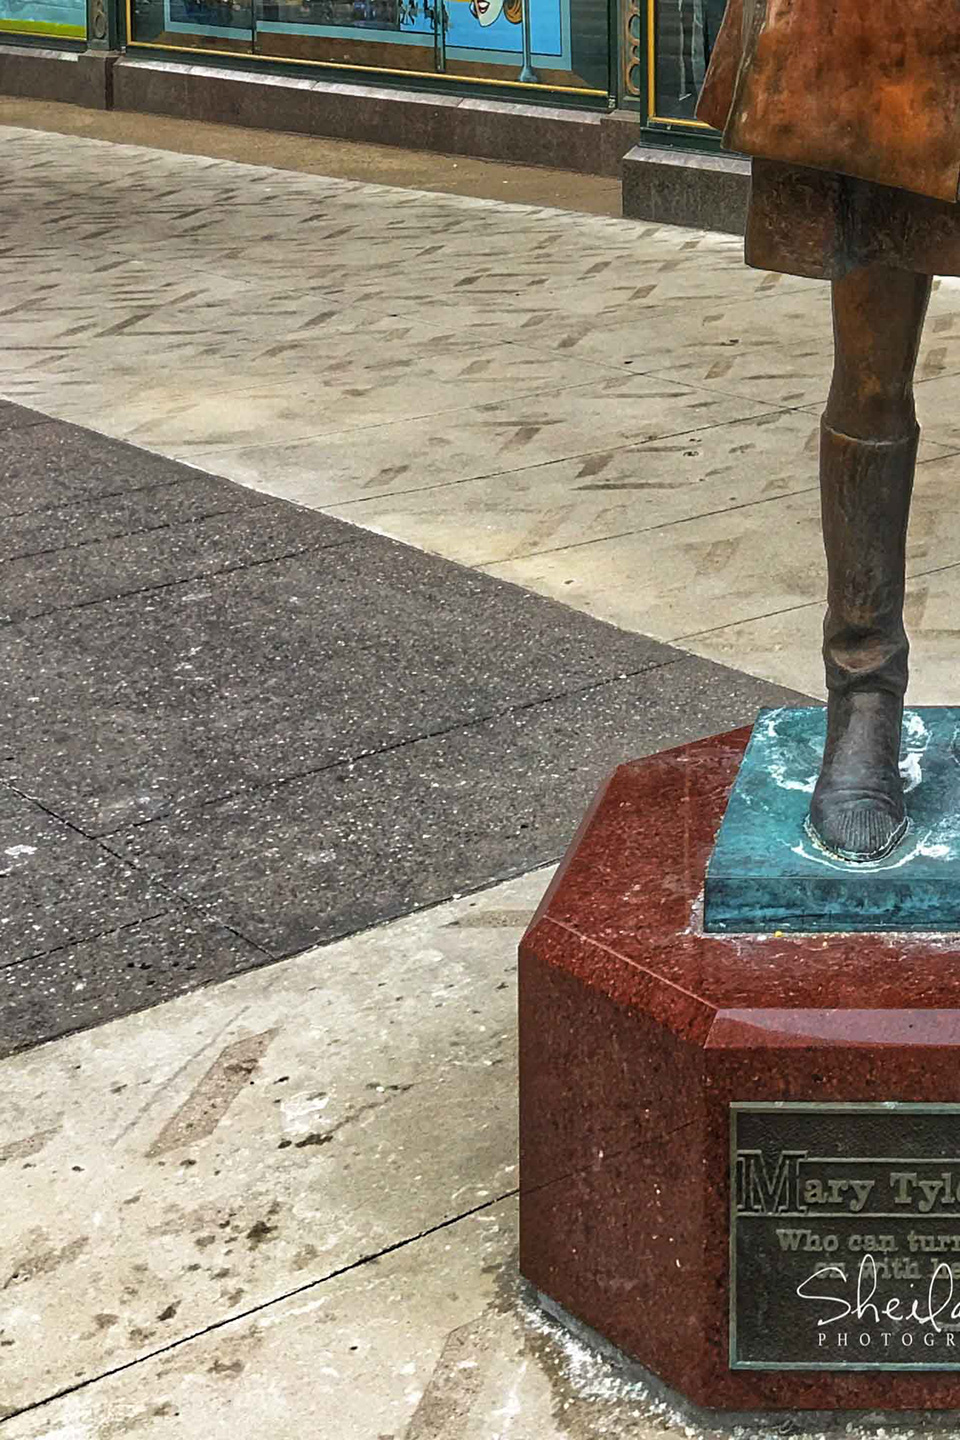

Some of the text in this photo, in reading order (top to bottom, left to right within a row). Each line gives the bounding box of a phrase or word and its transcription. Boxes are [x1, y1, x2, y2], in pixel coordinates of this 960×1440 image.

[736, 1149, 876, 1216] Mary
[775, 1228, 840, 1252] Who
[847, 1233, 899, 1252] can
[857, 1257, 923, 1280] with
